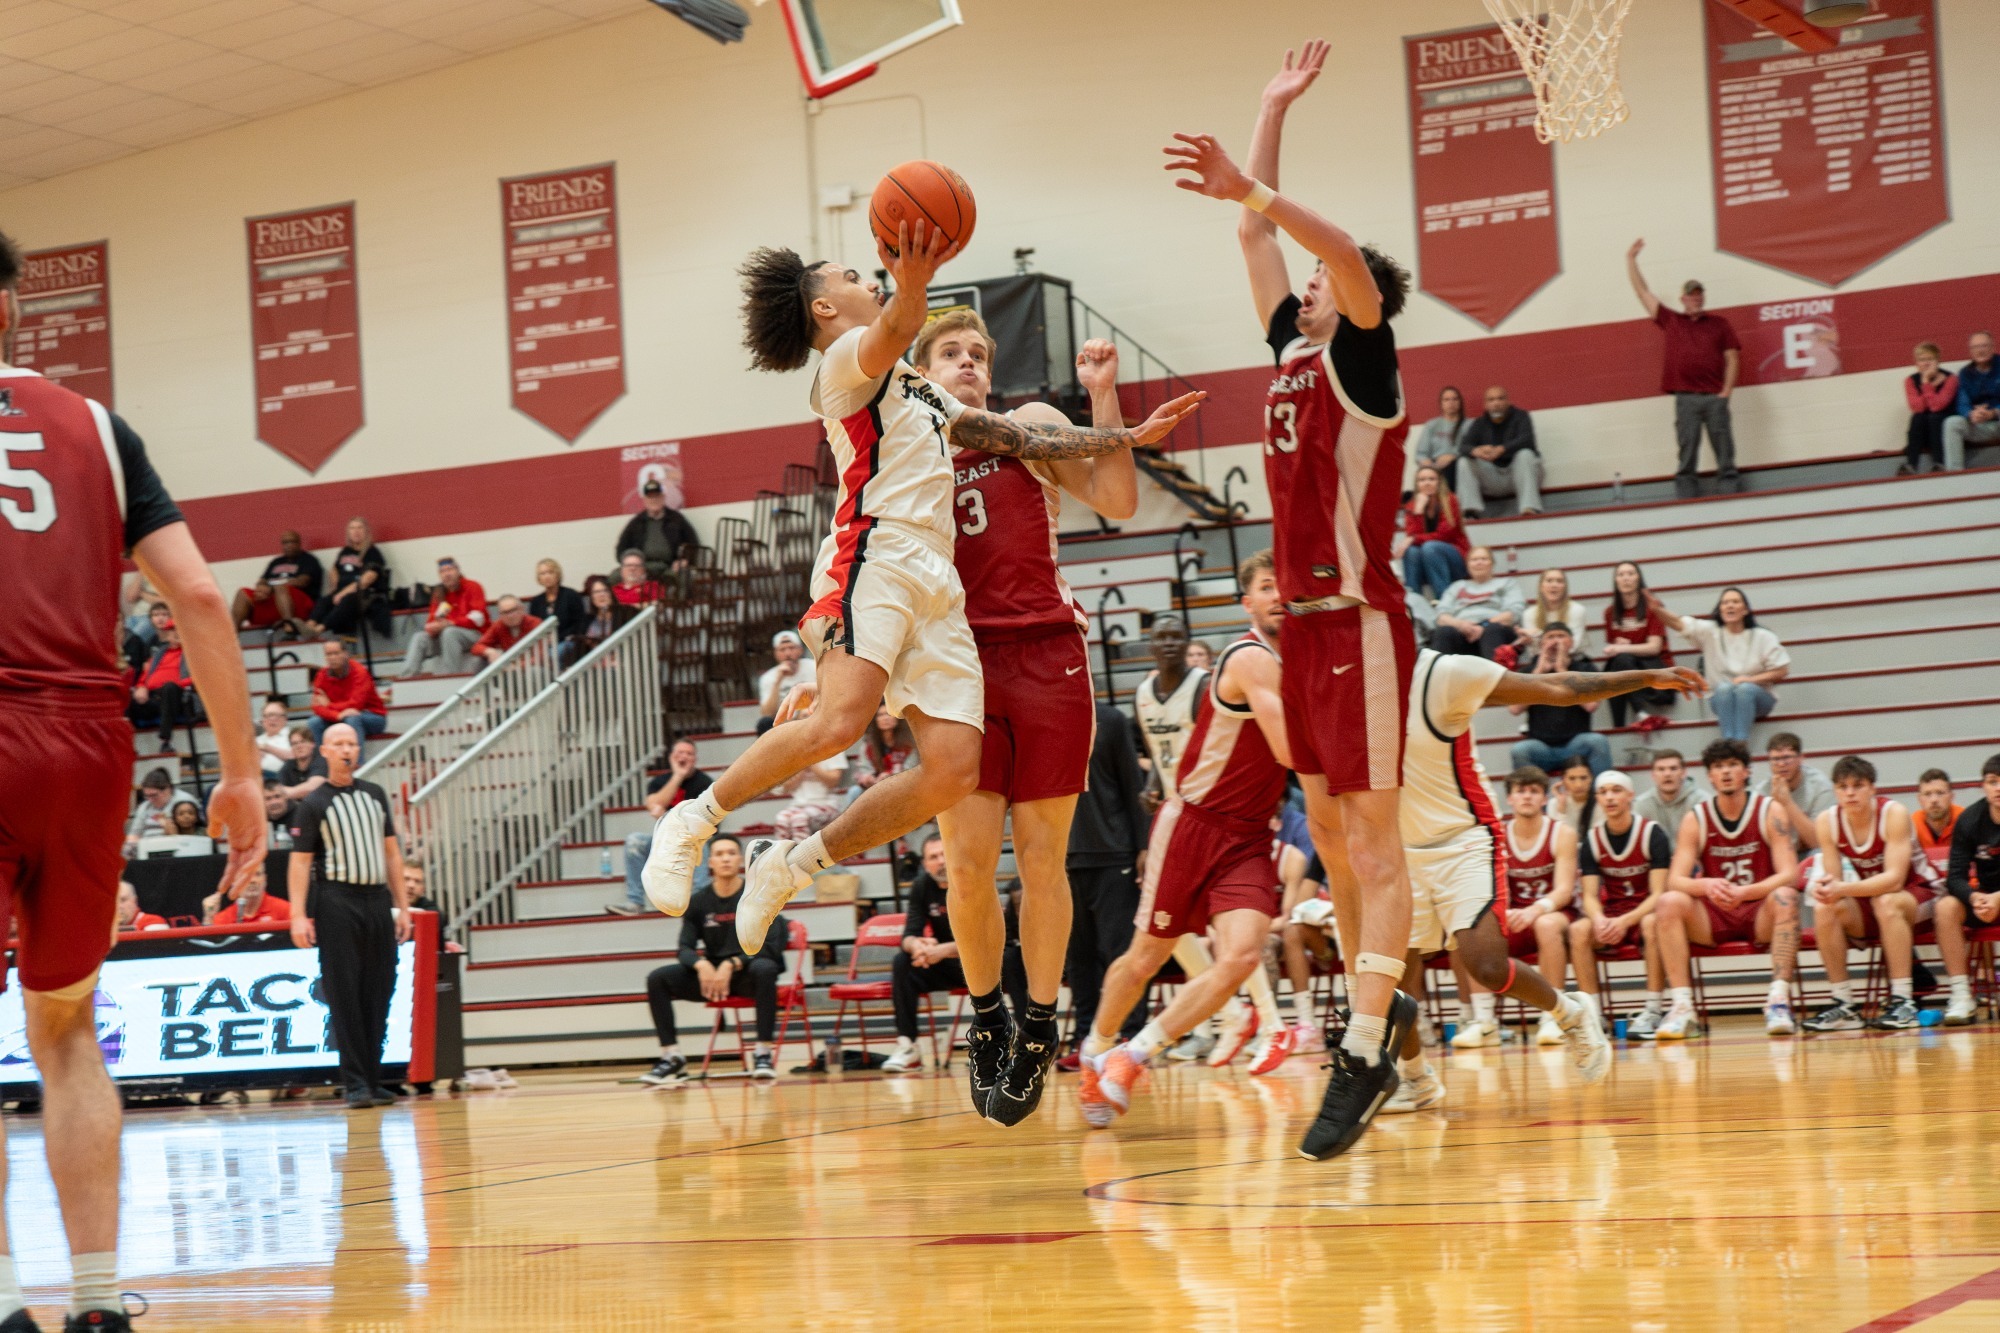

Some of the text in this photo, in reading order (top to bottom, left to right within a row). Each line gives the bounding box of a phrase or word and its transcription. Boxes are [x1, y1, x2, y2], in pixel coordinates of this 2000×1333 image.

[1418, 32, 1515, 67] FRIEND
[510, 173, 606, 206] FRIENDS
[509, 195, 604, 220] UNIVERSITY
[256, 212, 345, 245] FRIENDS
[254, 233, 345, 257] UNIVERSITY
[21, 270, 98, 293] NIVERSITY
[1759, 299, 1833, 322] SECTION
[1783, 322, 1817, 369] E
[621, 442, 679, 462] SECTION
[0, 431, 58, 533] 5
[1720, 858, 1755, 886] 25
[144, 972, 332, 1018] TAC
